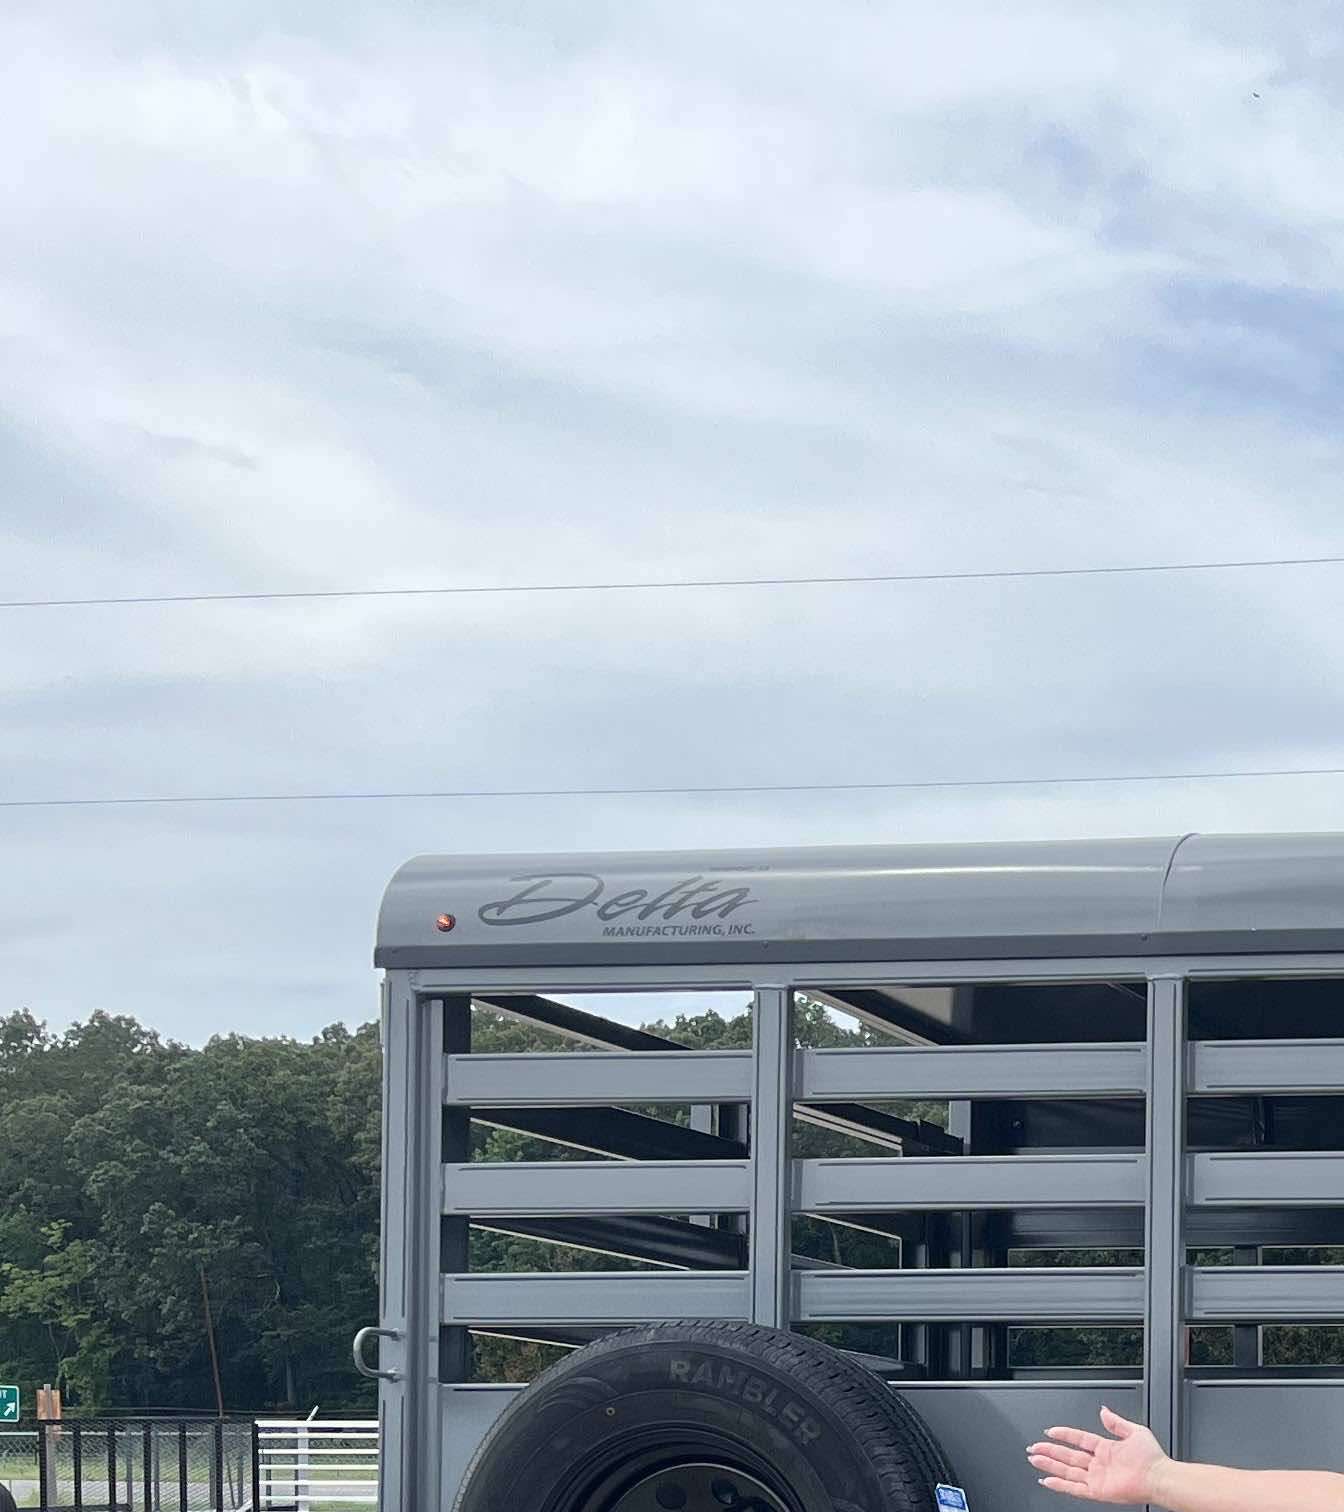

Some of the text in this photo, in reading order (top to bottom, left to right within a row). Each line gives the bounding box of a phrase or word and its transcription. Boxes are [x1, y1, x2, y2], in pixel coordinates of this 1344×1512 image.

[478, 873, 759, 926] Delta
[602, 923, 756, 937] MANUFACTURING, INC.
[669, 1359, 822, 1446] RAMBLER
